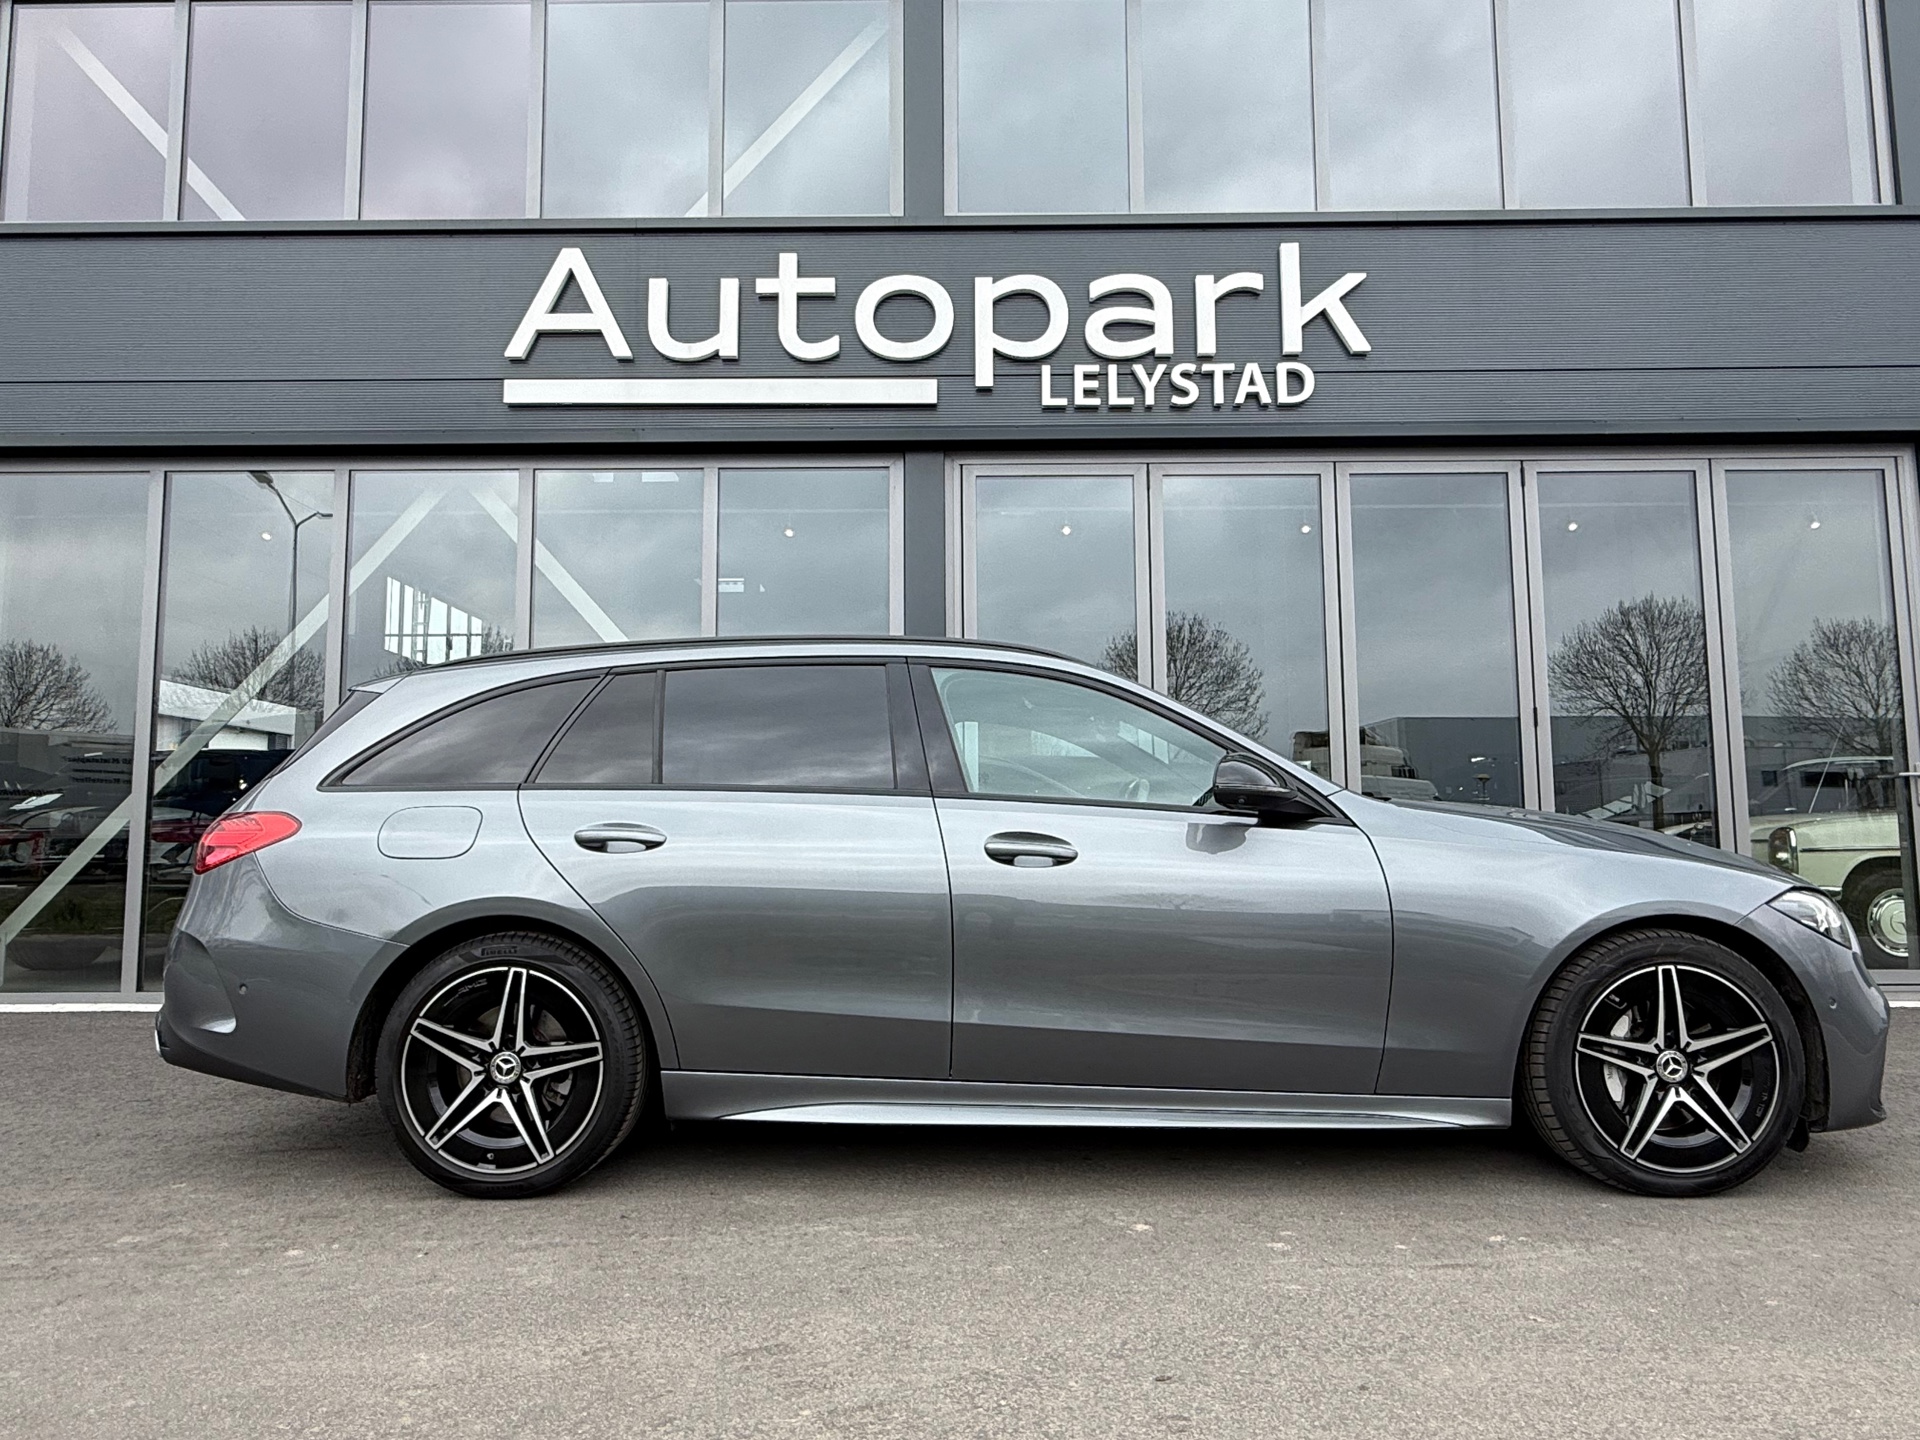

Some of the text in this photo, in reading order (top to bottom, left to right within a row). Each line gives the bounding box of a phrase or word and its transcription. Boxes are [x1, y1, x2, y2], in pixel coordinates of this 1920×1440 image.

[503, 241, 1372, 389] Autopark
[1041, 362, 1316, 410] LELYSTAD
[481, 946, 518, 957] PIRELLI
